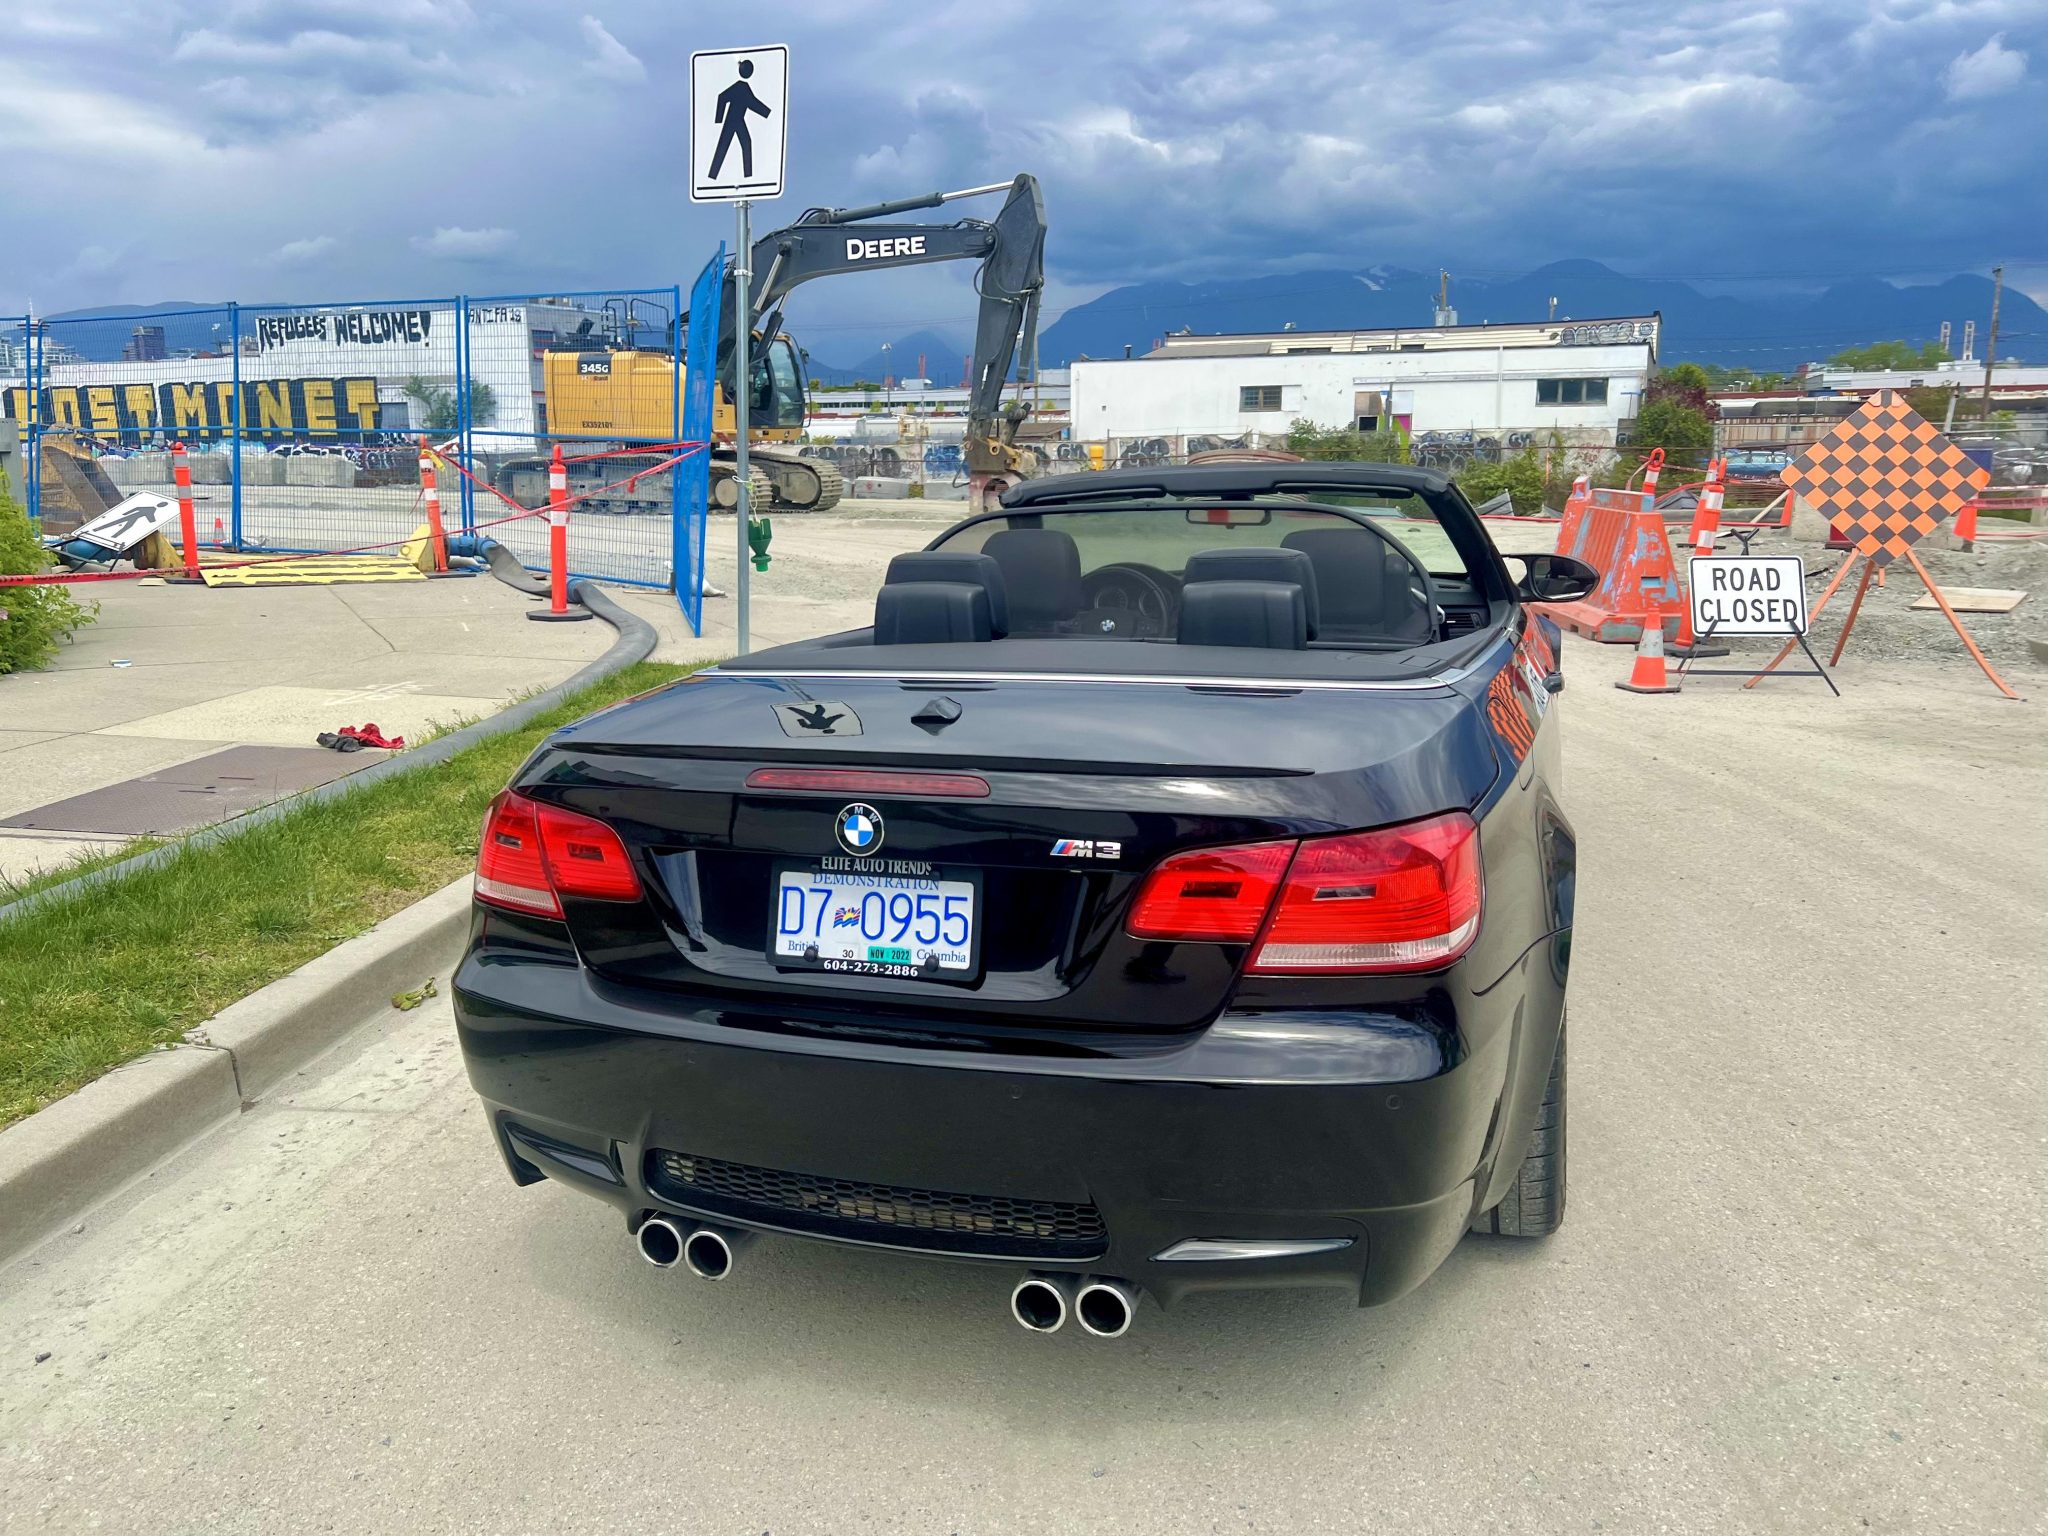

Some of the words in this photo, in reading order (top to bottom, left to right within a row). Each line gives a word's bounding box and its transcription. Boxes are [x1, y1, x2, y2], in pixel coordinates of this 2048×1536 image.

[846, 235, 926, 261] DEERE
[258, 314, 327, 352] REFUGEES
[333, 310, 432, 347] WELCOME!
[580, 363, 609, 373] 345G
[1711, 566, 1781, 592] ROAD
[1699, 597, 1799, 624] CLOSED
[840, 805, 880, 824] BMW
[1052, 838, 1122, 860] M3
[821, 856, 852, 871] ELITE
[852, 858, 885, 873] AUTO
[887, 860, 933, 876] TRENDS
[812, 872, 940, 892] DEMONSTRATION
[779, 885, 833, 937] D7
[860, 891, 969, 947] 0955
[842, 948, 854, 959] 30
[870, 948, 885, 959] NOV
[891, 949, 911, 961] 2022
[823, 959, 919, 977] 604-273-2886
